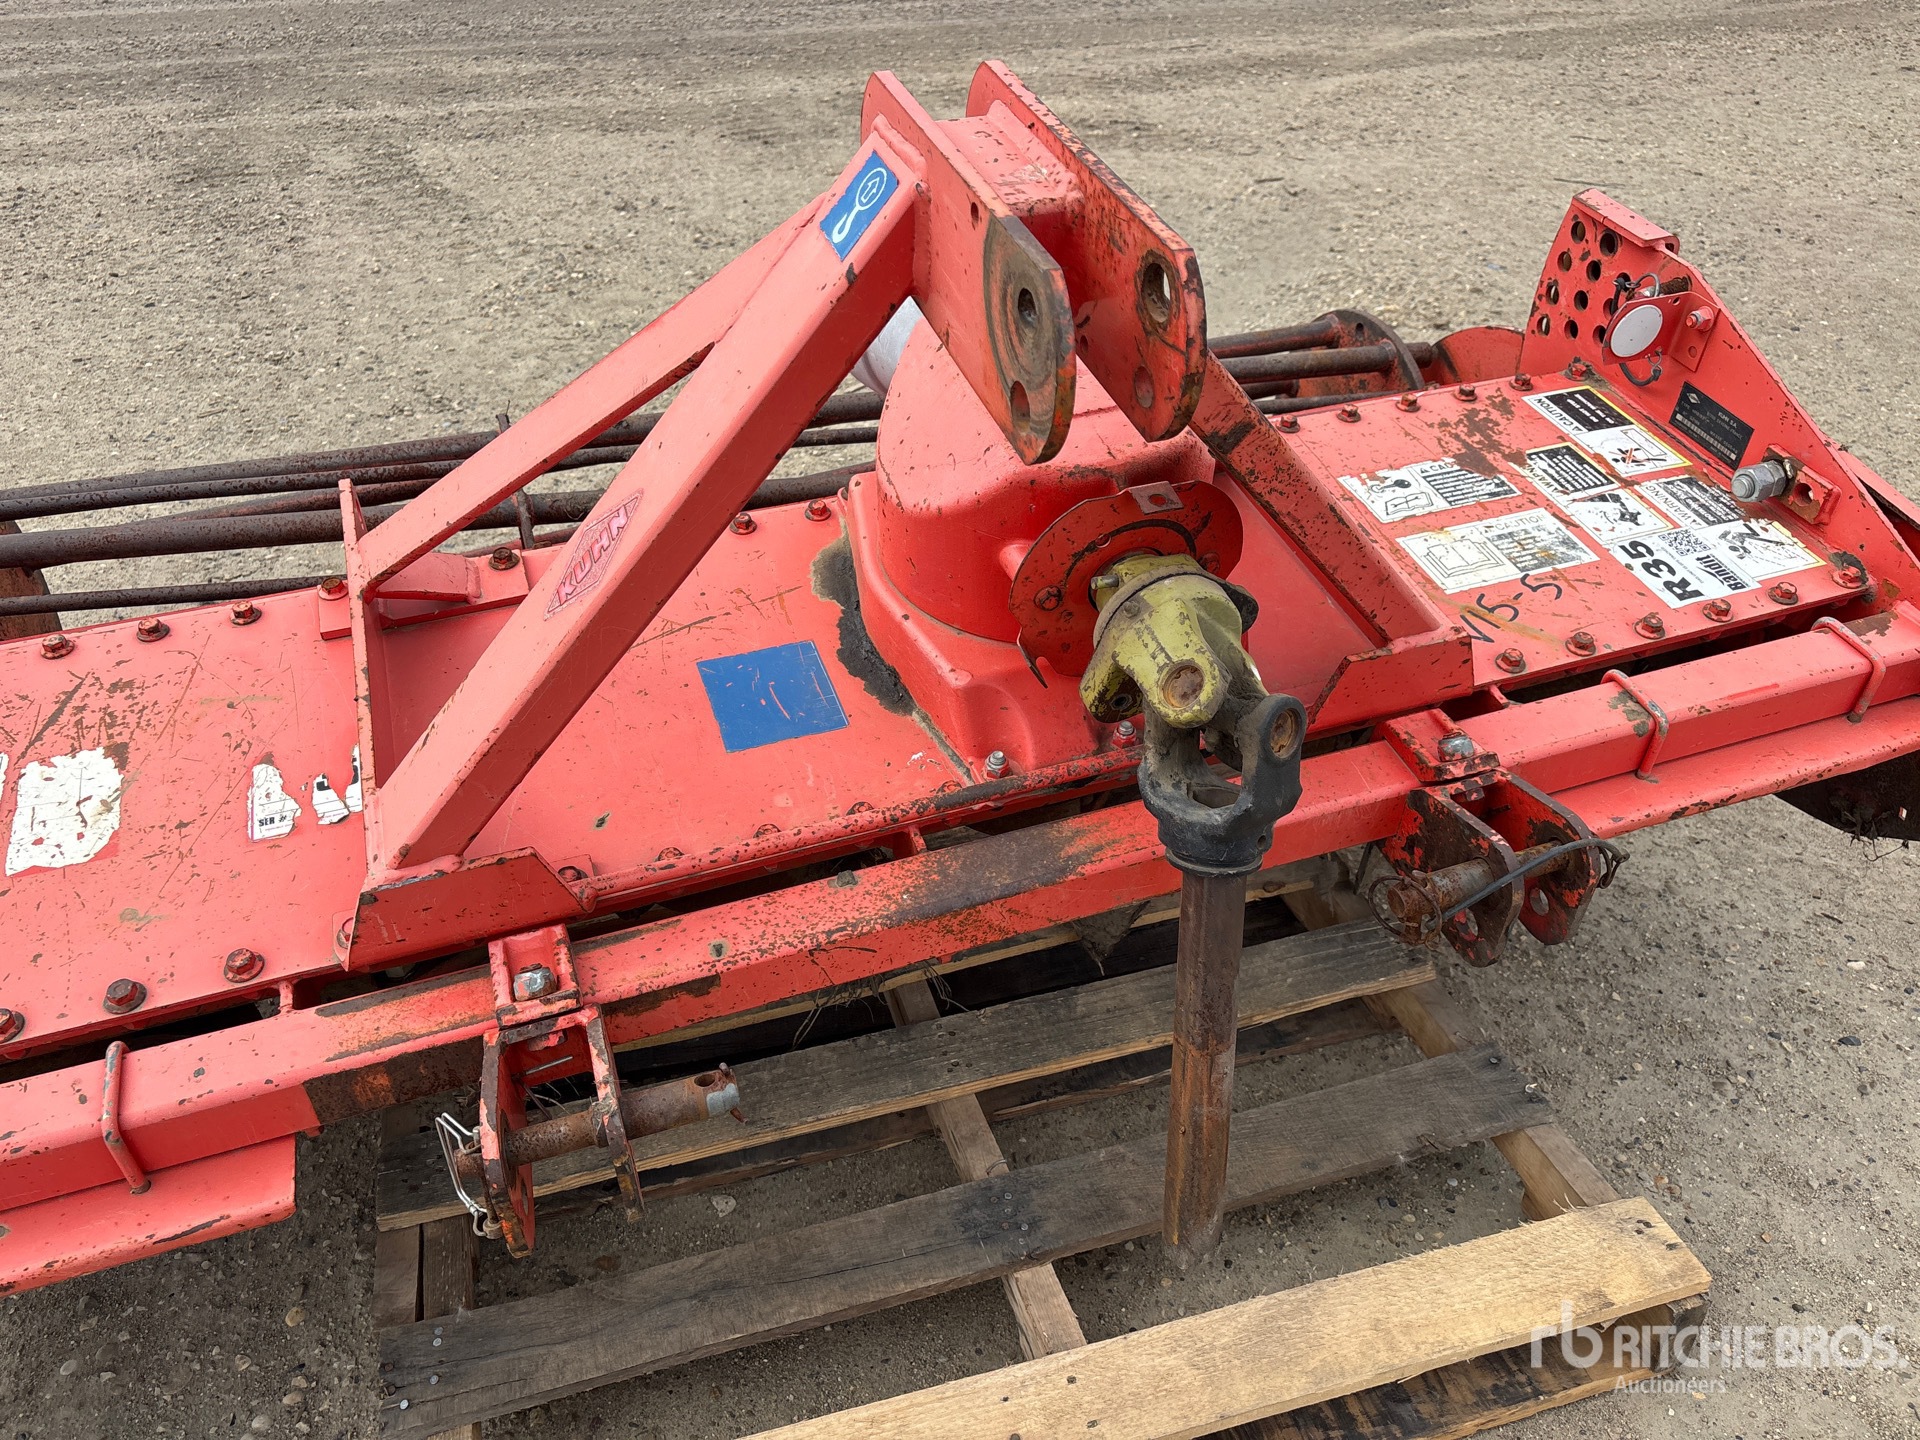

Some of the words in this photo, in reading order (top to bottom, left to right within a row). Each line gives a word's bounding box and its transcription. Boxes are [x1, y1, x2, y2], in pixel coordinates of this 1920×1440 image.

[1533, 397, 1574, 426] CAUTION
[1526, 463, 1556, 490] WARN
[1645, 485, 1692, 520] WARNING
[1494, 513, 1546, 531] CAUTION
[556, 504, 629, 606] KUHN
[1618, 540, 1705, 601] R35
[1695, 554, 1747, 591] Bandit
[258, 816, 276, 827] SER
